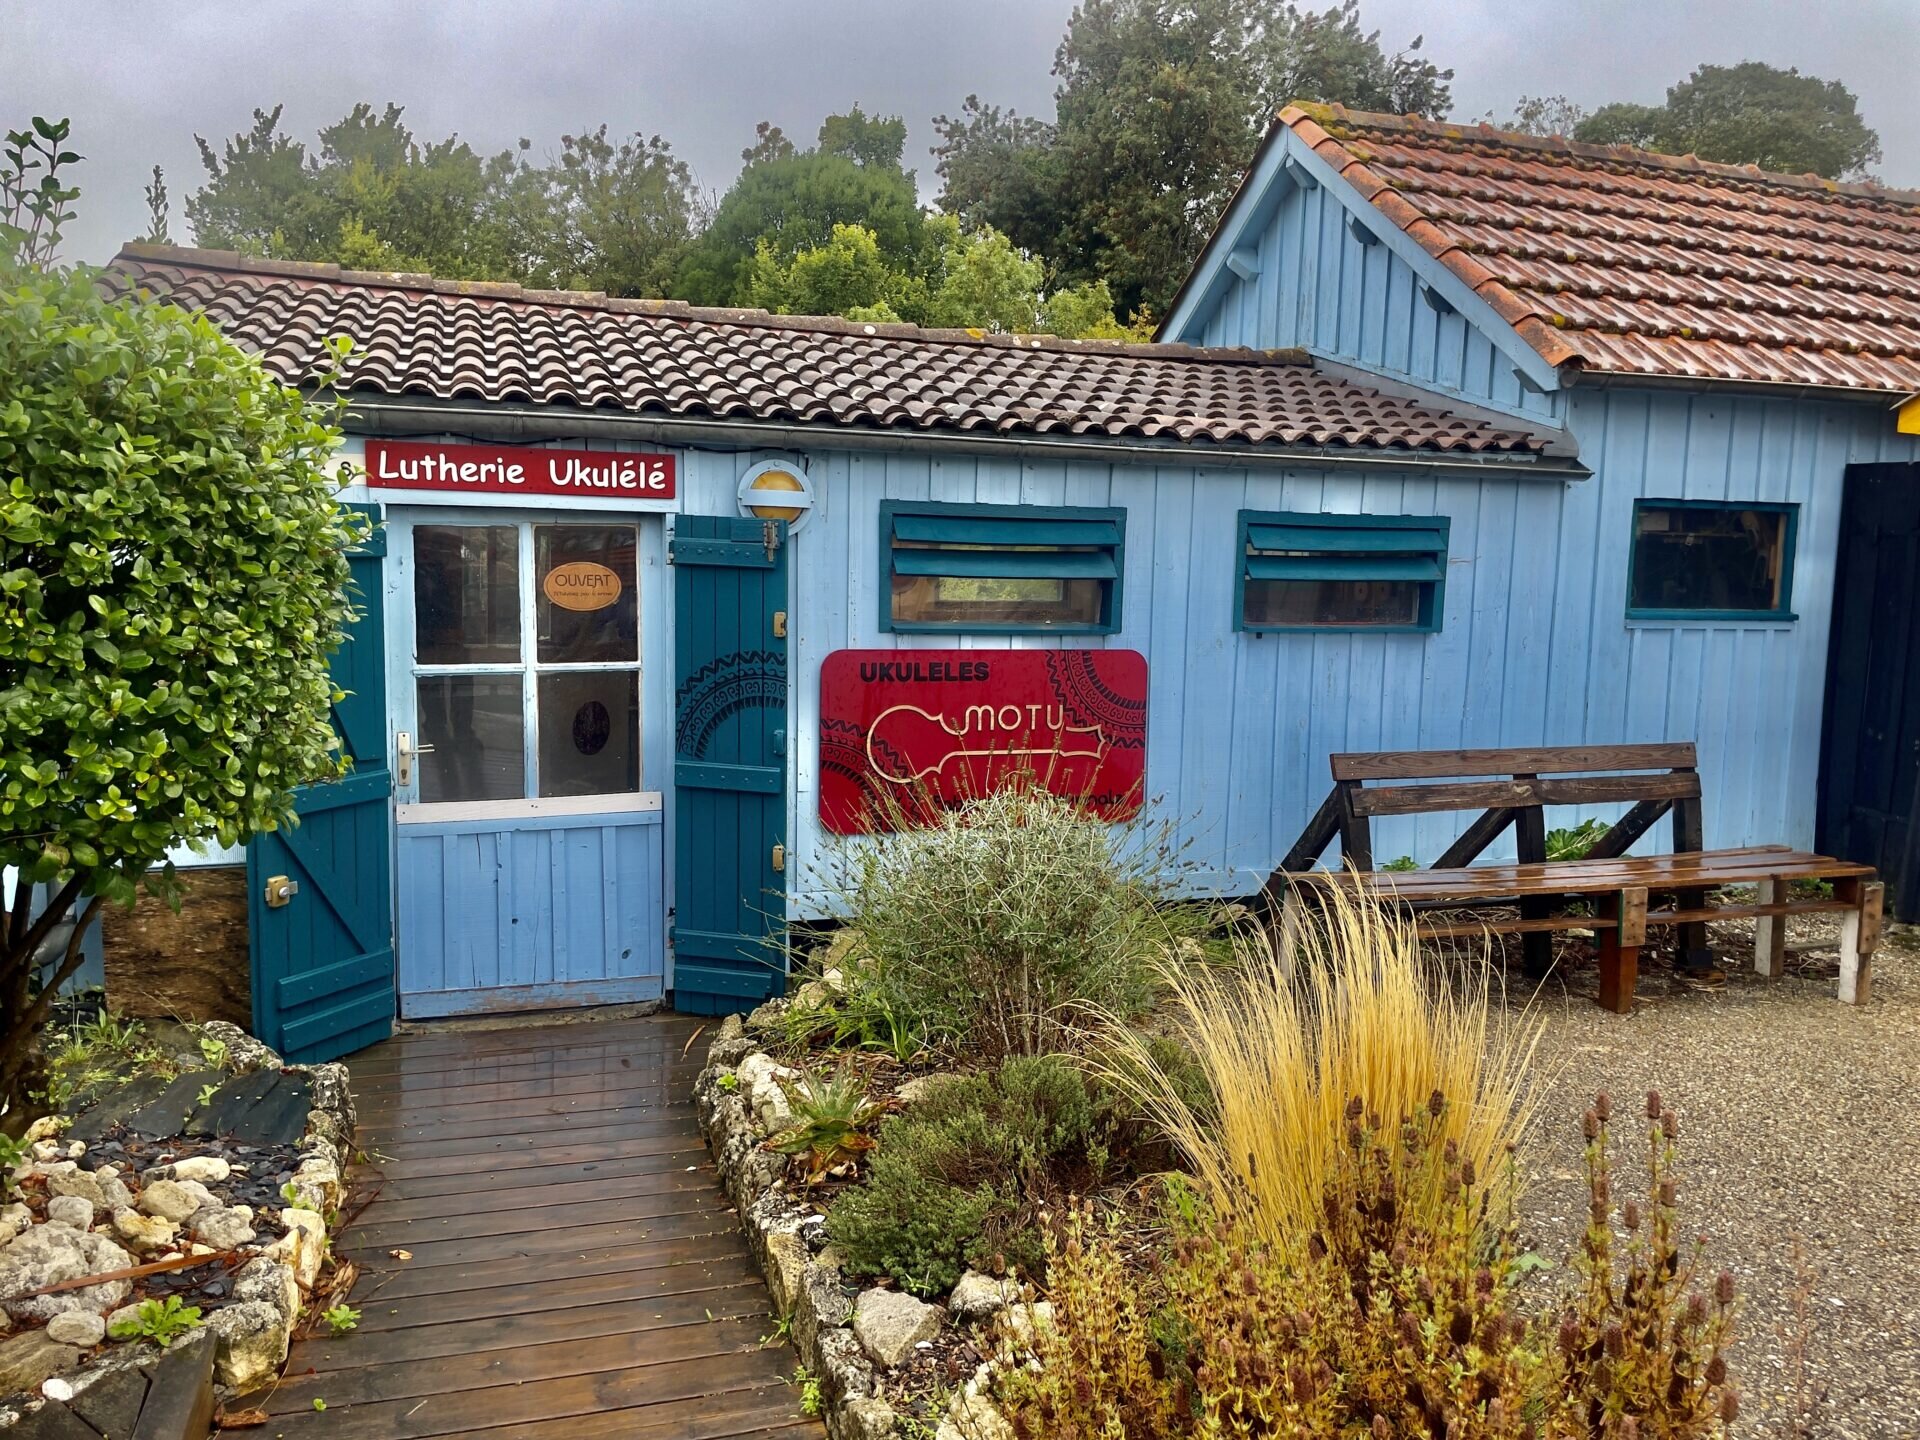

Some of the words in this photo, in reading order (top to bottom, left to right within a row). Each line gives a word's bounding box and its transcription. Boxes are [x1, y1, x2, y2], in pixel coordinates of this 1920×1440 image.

[378, 450, 526, 485] Lutherie
[549, 457, 667, 490] Ukulélé
[554, 574, 611, 588] OUVERT
[860, 661, 990, 682] UKULELES
[966, 704, 1064, 731] MOTU
